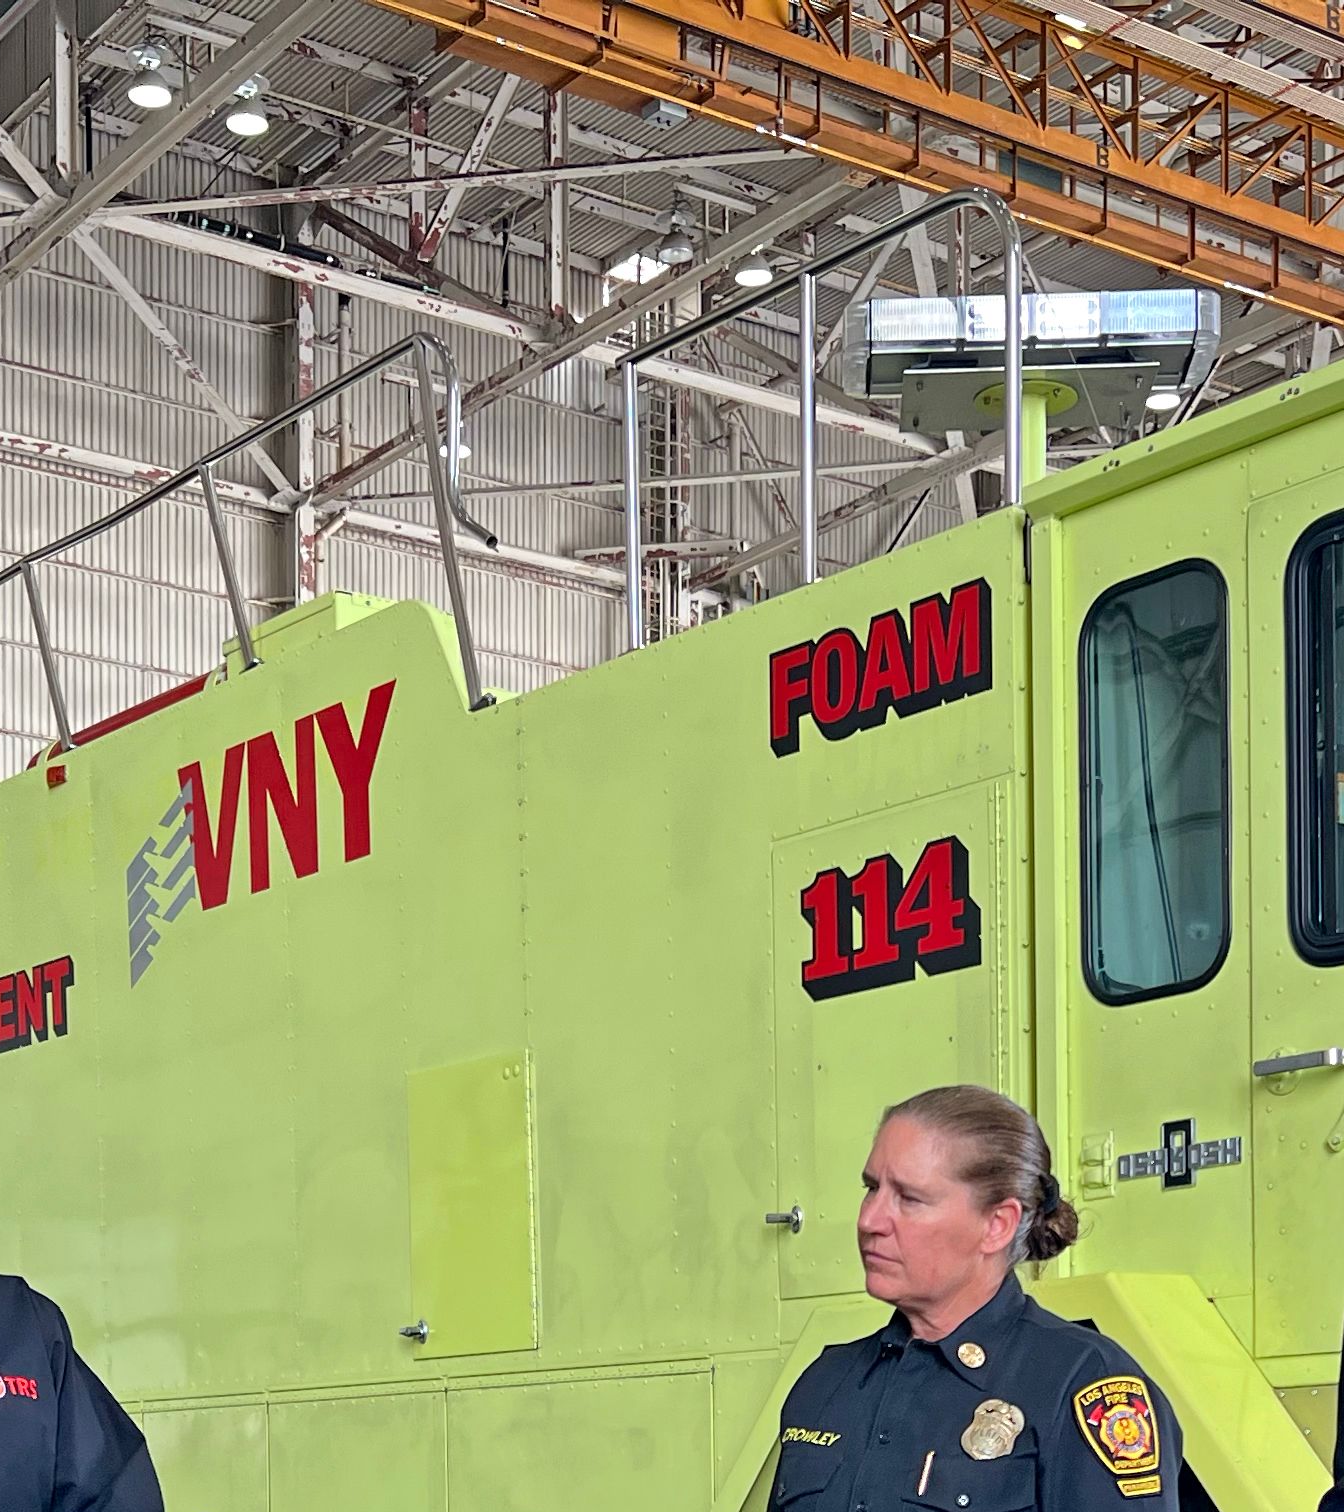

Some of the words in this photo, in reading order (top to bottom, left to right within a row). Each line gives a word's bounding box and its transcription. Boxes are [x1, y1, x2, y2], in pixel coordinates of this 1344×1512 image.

[769, 576, 993, 759] FOAM
[177, 678, 397, 911] VNY
[800, 834, 982, 1003] 114
[3, 1375, 38, 1400] TRS
[1079, 1388, 1103, 1406] LOS
[1102, 1382, 1143, 1396] ANGELES
[1104, 1392, 1129, 1406] FIRE
